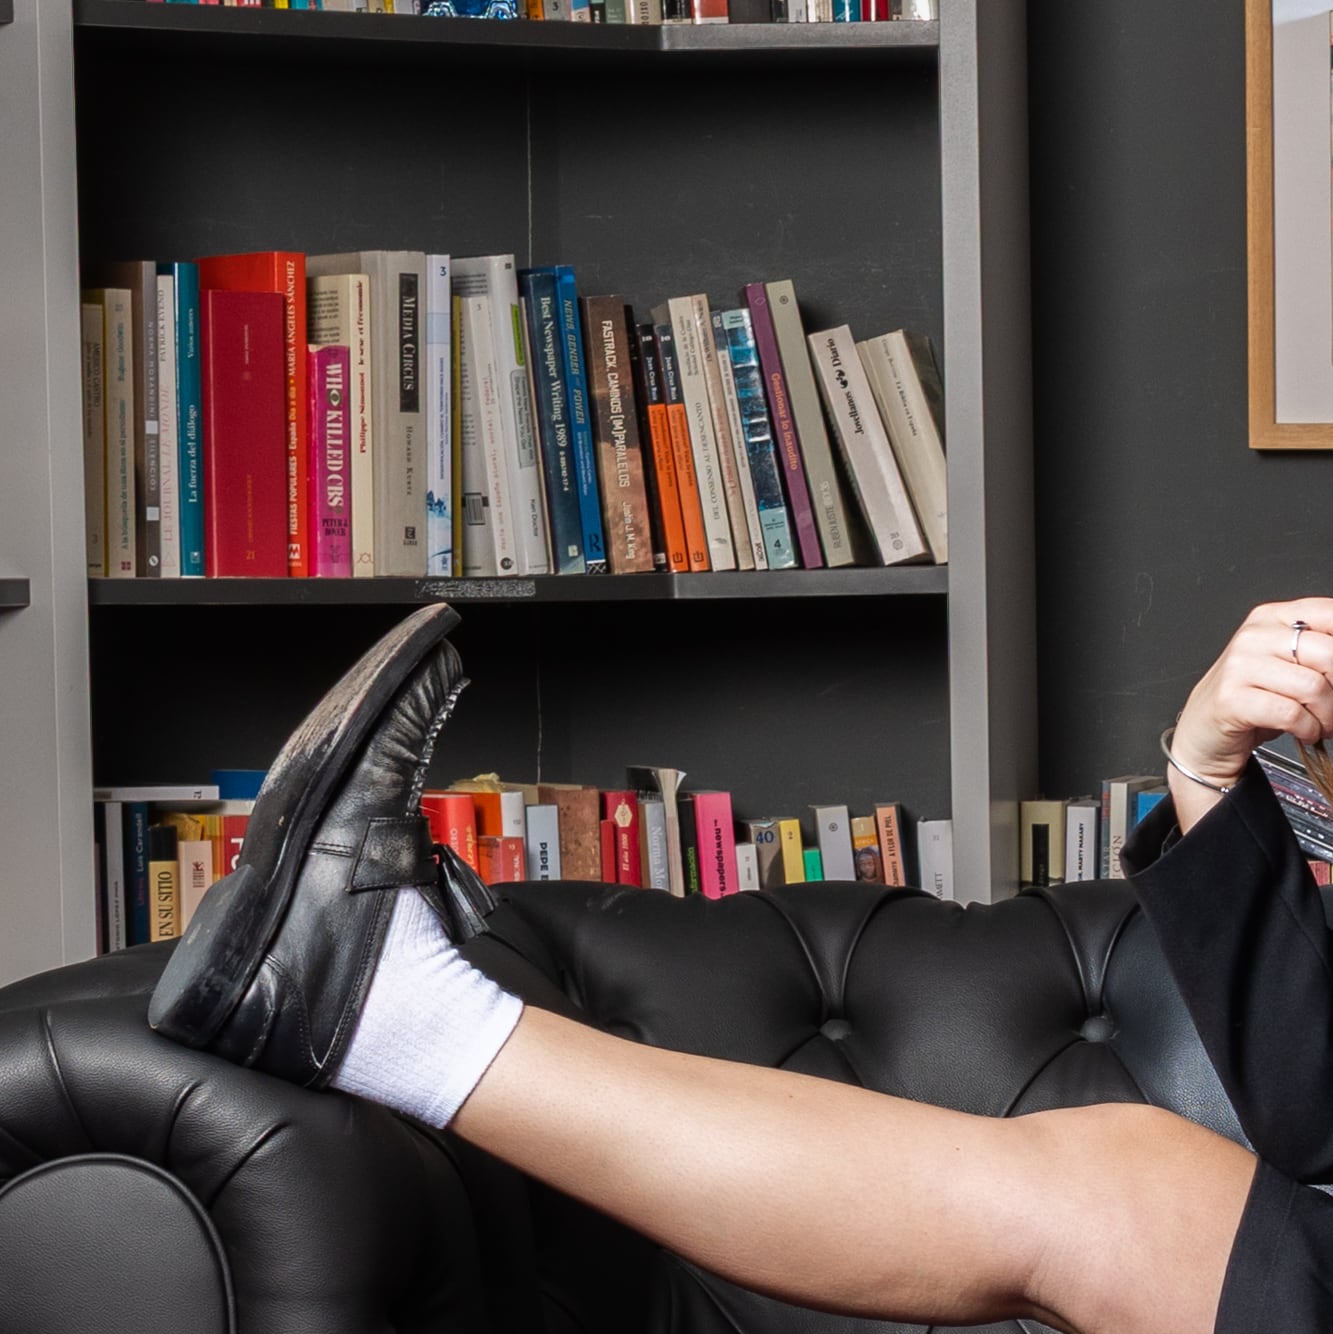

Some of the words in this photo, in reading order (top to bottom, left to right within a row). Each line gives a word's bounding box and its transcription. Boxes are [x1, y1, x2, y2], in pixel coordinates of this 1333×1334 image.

[284, 260, 296, 303] SÁNCHEZ
[157, 289, 166, 322] EVENO
[403, 296, 416, 339] MEDIA
[540, 296, 553, 319] Best
[563, 299, 575, 331] NEWS,
[285, 305, 296, 344] ÁNGELES
[158, 328, 167, 362] PATRICK
[542, 320, 558, 378] Newspaper
[567, 334, 580, 375] GENDER
[826, 338, 841, 367] Diario
[286, 346, 296, 376] MARÍA
[403, 342, 416, 391] CIRCUS
[606, 373, 621, 413] CAMINOS
[666, 370, 676, 385] Cruz
[160, 384, 170, 433] MONDE
[548, 380, 564, 422] Writing
[574, 388, 585, 425] POWER
[668, 387, 678, 400] Ruiz
[771, 372, 786, 418] Gestionar
[186, 404, 197, 440] diálogo
[696, 402, 709, 452] DESENCANTO
[781, 419, 789, 429] lo
[844, 392, 864, 435] Jovellanos
[161, 442, 170, 457] LE
[187, 442, 197, 457] del
[289, 422, 299, 450] España
[326, 409, 344, 472] KILLED
[555, 423, 568, 447] 1989
[783, 430, 799, 470] inaudito
[704, 452, 711, 462] AL
[188, 459, 198, 488] fuerza
[289, 456, 298, 502] POPULARES
[706, 465, 718, 504] CONSENSO
[162, 465, 172, 521] JOURNAL
[188, 490, 198, 503] La
[530, 498, 538, 511] Ken
[289, 503, 298, 535] FIESTAS
[531, 513, 539, 537] Doctor
[712, 506, 720, 520] DEL
[163, 530, 172, 541] LE
[773, 538, 781, 549] 4
[134, 813, 144, 854] Carandell
[883, 815, 892, 828] PIEL
[651, 826, 663, 864] Norma
[755, 831, 774, 845] 40
[887, 837, 895, 852] FLOR
[136, 856, 144, 872] Luis
[538, 841, 549, 871] PEPE
[714, 827, 727, 892] newspapers
[157, 871, 173, 902] SITIO
[158, 904, 173, 919] SU
[158, 921, 174, 937] EN
